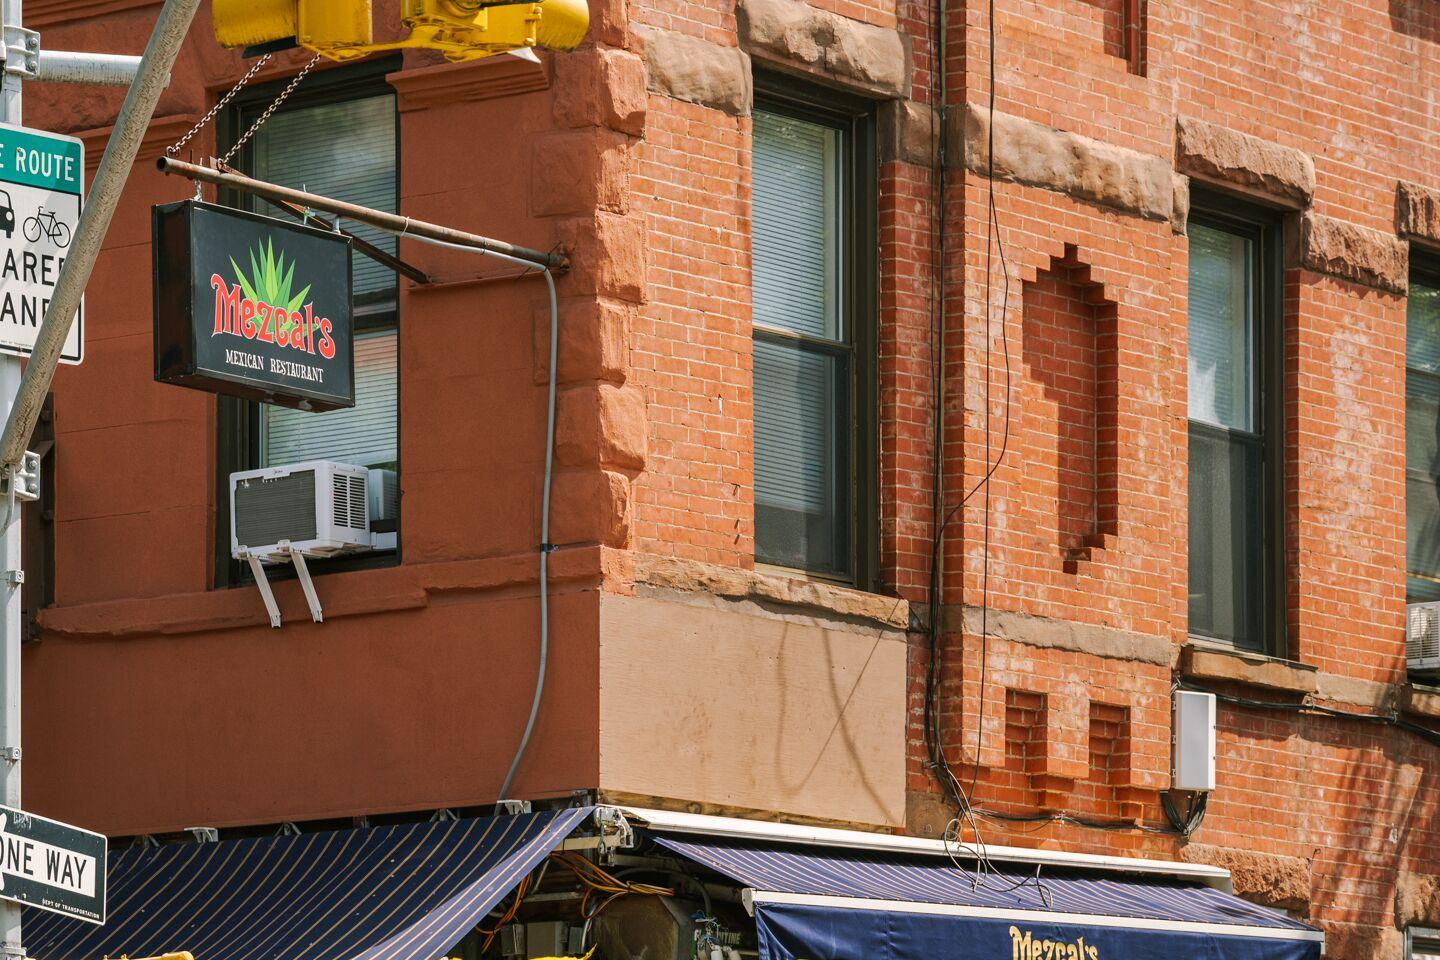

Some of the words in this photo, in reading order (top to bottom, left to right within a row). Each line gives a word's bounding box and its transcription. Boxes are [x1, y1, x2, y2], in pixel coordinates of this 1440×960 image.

[15, 146, 74, 182] ROUTE
[210, 273, 336, 359] Mezcal's
[225, 349, 264, 370] MEXICAN
[270, 358, 323, 383] RESTAURANT
[46, 848, 87, 889] WAY
